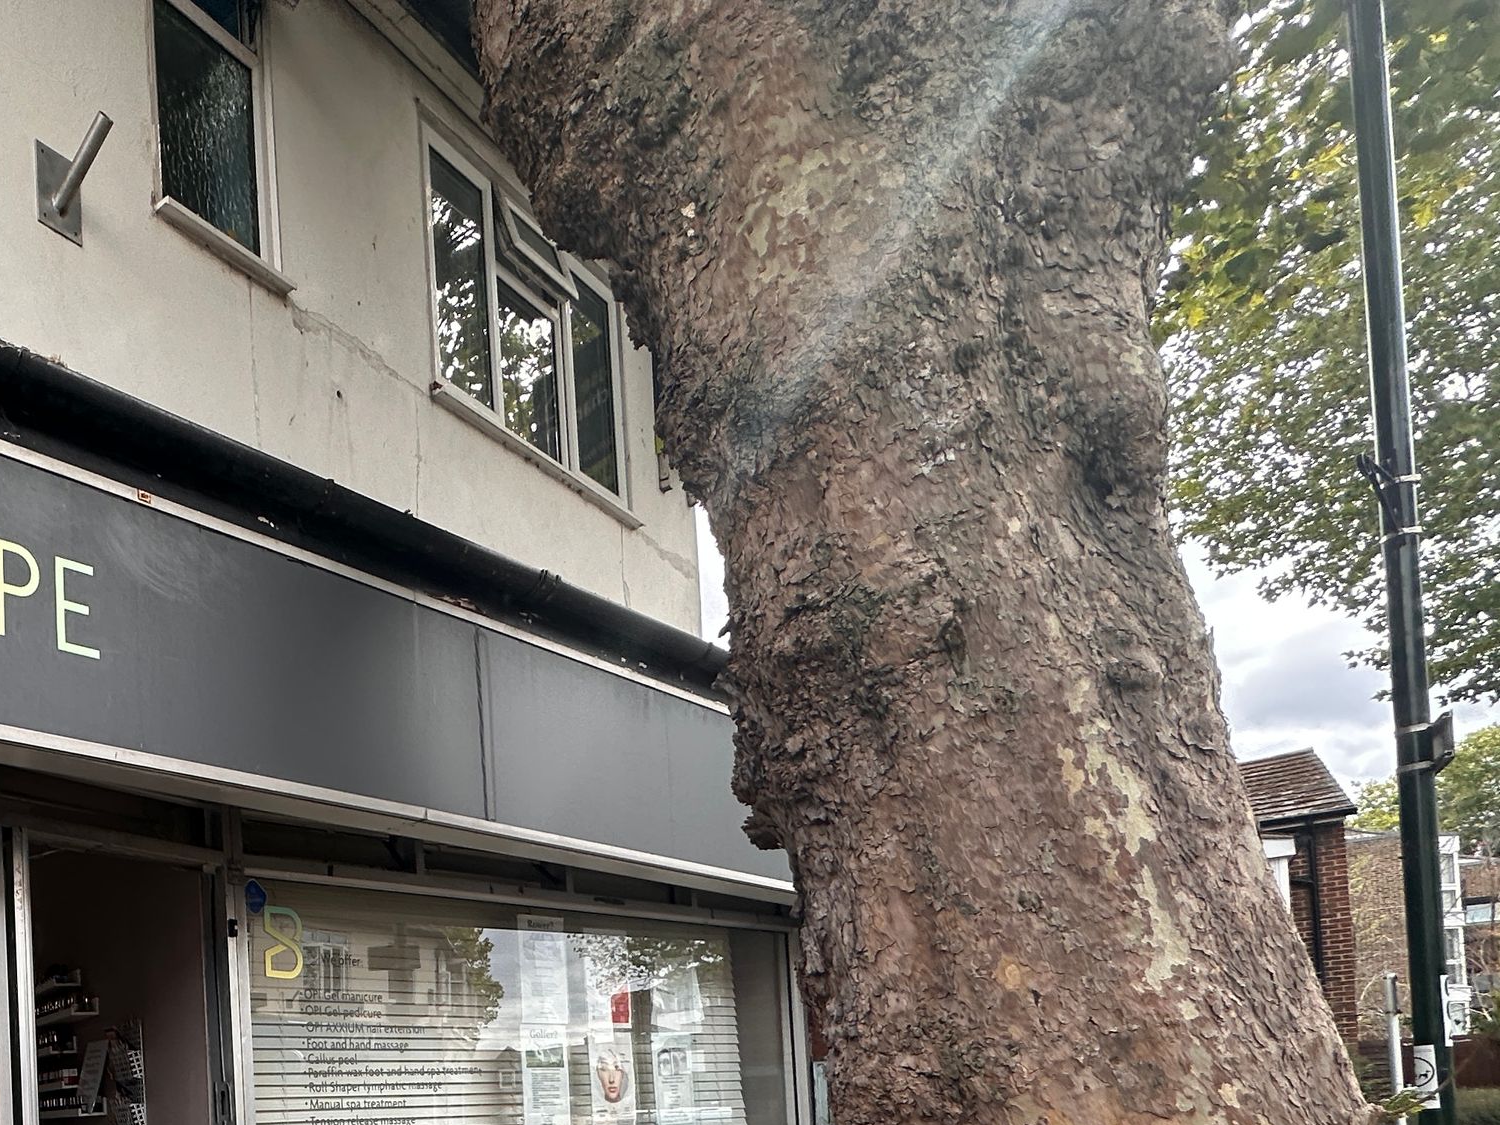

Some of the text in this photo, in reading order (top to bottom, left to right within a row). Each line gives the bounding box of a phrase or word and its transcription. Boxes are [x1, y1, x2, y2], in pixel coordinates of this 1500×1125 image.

[304, 991, 322, 1000] OPI
[342, 992, 383, 1003] manicure
[305, 1006, 322, 1015] OPI
[343, 1007, 382, 1019] pedicure
[384, 1025, 426, 1034] extension
[307, 1040, 409, 1053] Foot and hand massage
[307, 1054, 358, 1067] Callus peel
[309, 1099, 407, 1112] Manual spa treatment
